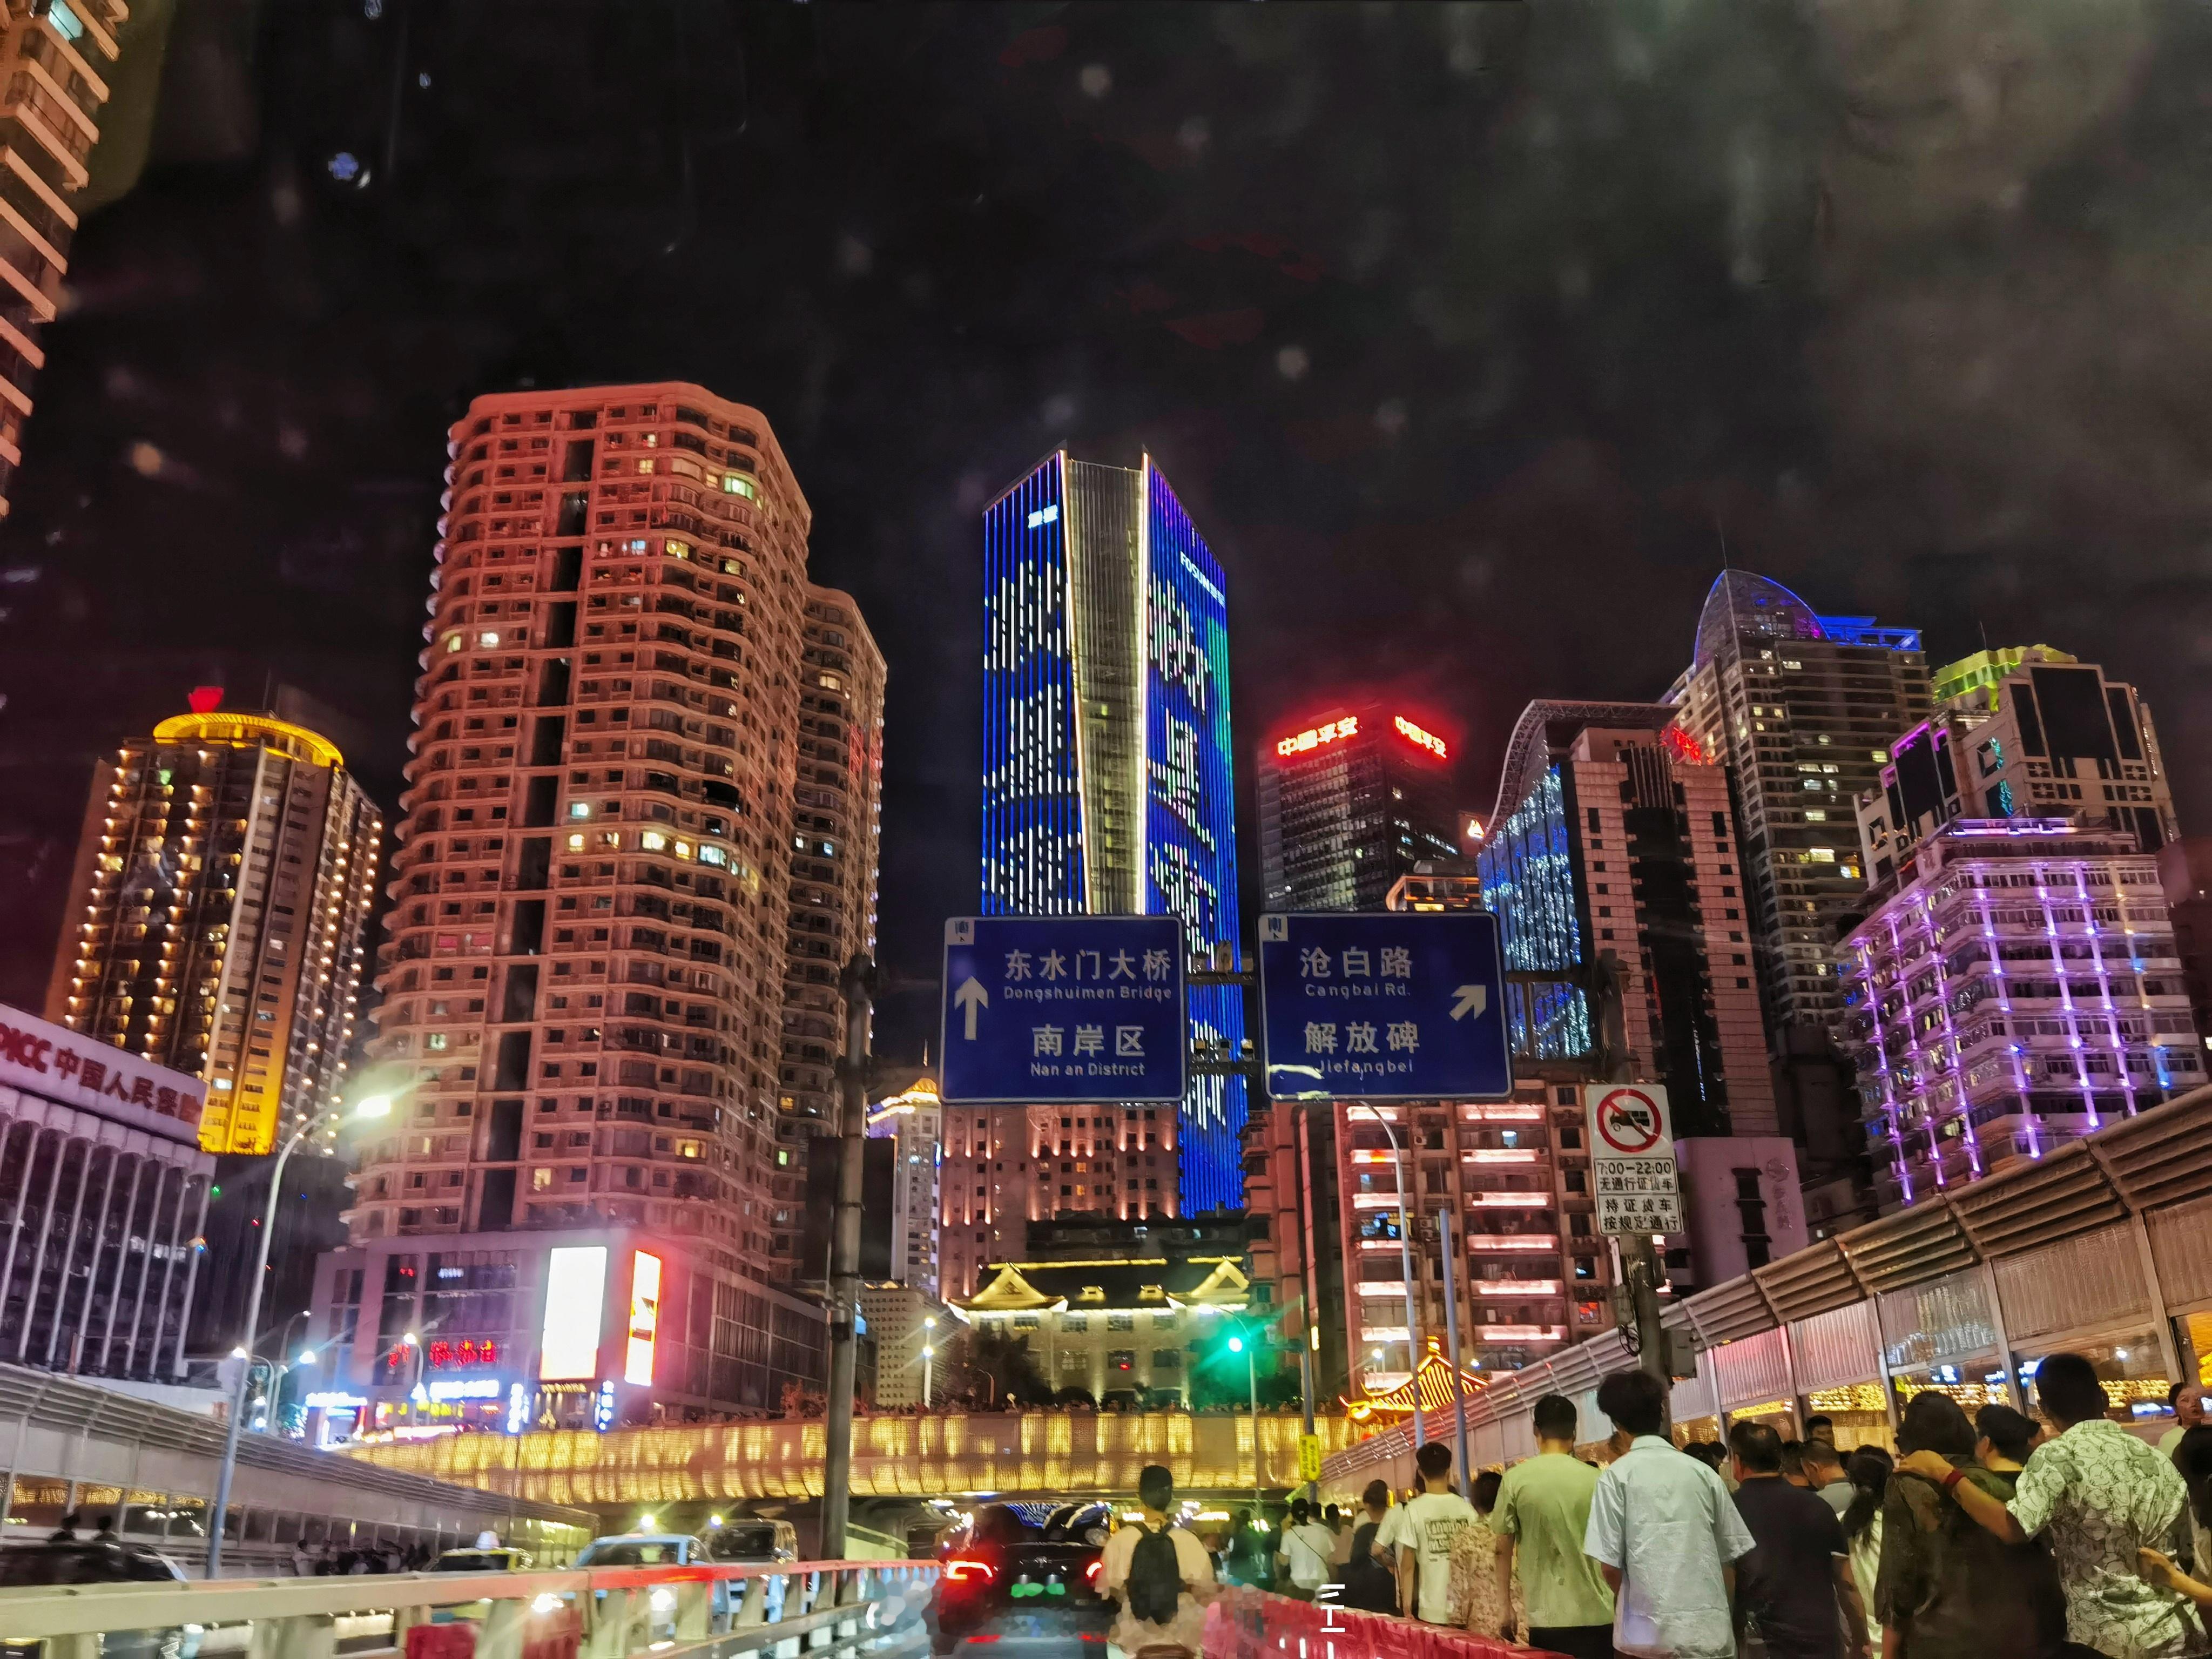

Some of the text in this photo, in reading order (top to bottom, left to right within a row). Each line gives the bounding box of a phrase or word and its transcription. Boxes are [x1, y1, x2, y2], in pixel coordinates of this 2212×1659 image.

[1180, 550, 1210, 592] FOSUN
[1004, 948, 1172, 982] 东水门大桥
[1300, 946, 1413, 979] 沧白路
[1003, 986, 1172, 1004] Dongshuimen Bridge
[1305, 982, 1411, 1000] Cangbai Rd.
[1031, 1023, 1145, 1058] 南岸区
[1304, 1021, 1420, 1054] 解放碑
[1088, 1062, 1145, 1077] District
[1319, 1059, 1413, 1075] Jiefangbei
